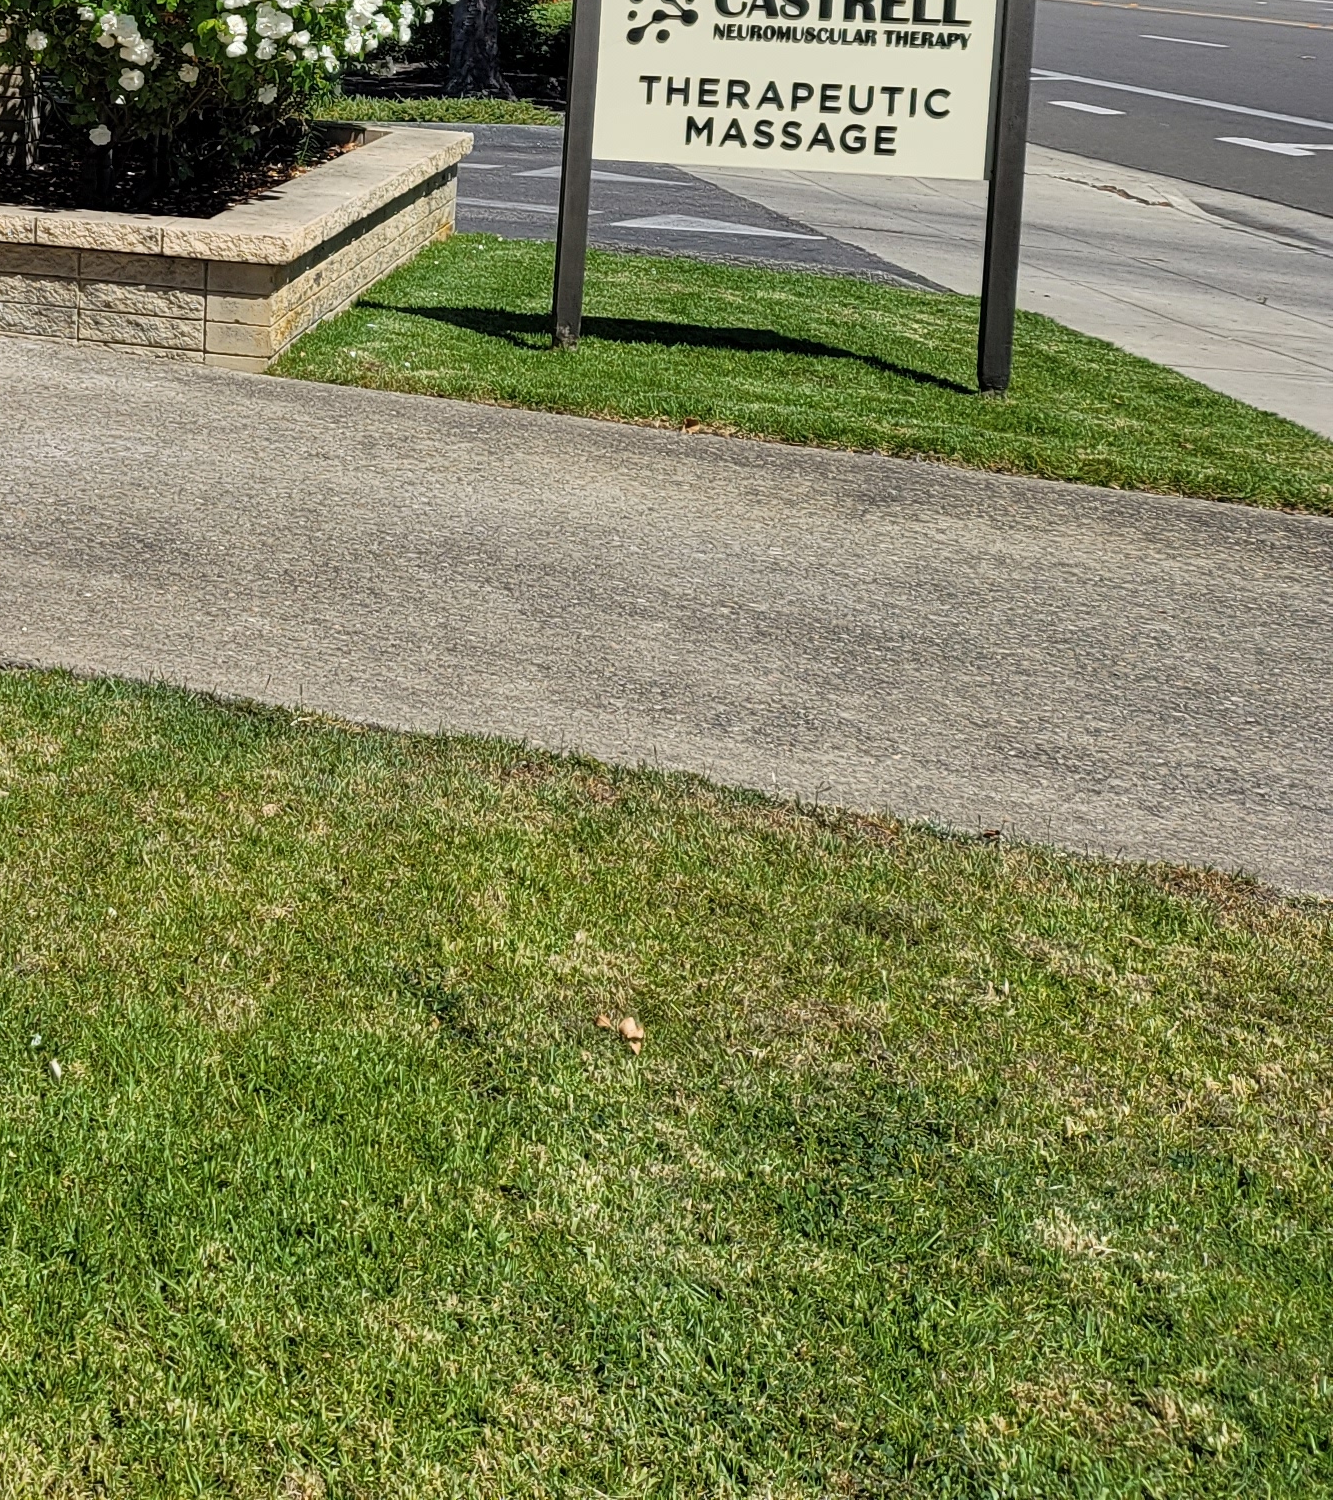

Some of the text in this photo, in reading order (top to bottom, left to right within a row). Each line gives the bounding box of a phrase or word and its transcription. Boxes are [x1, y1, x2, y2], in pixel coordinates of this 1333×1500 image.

[713, 23, 972, 51] NEUROMUSCULAR THERAPY
[638, 75, 952, 120] THERAPEUTIC
[685, 116, 898, 157] MASSAGE
